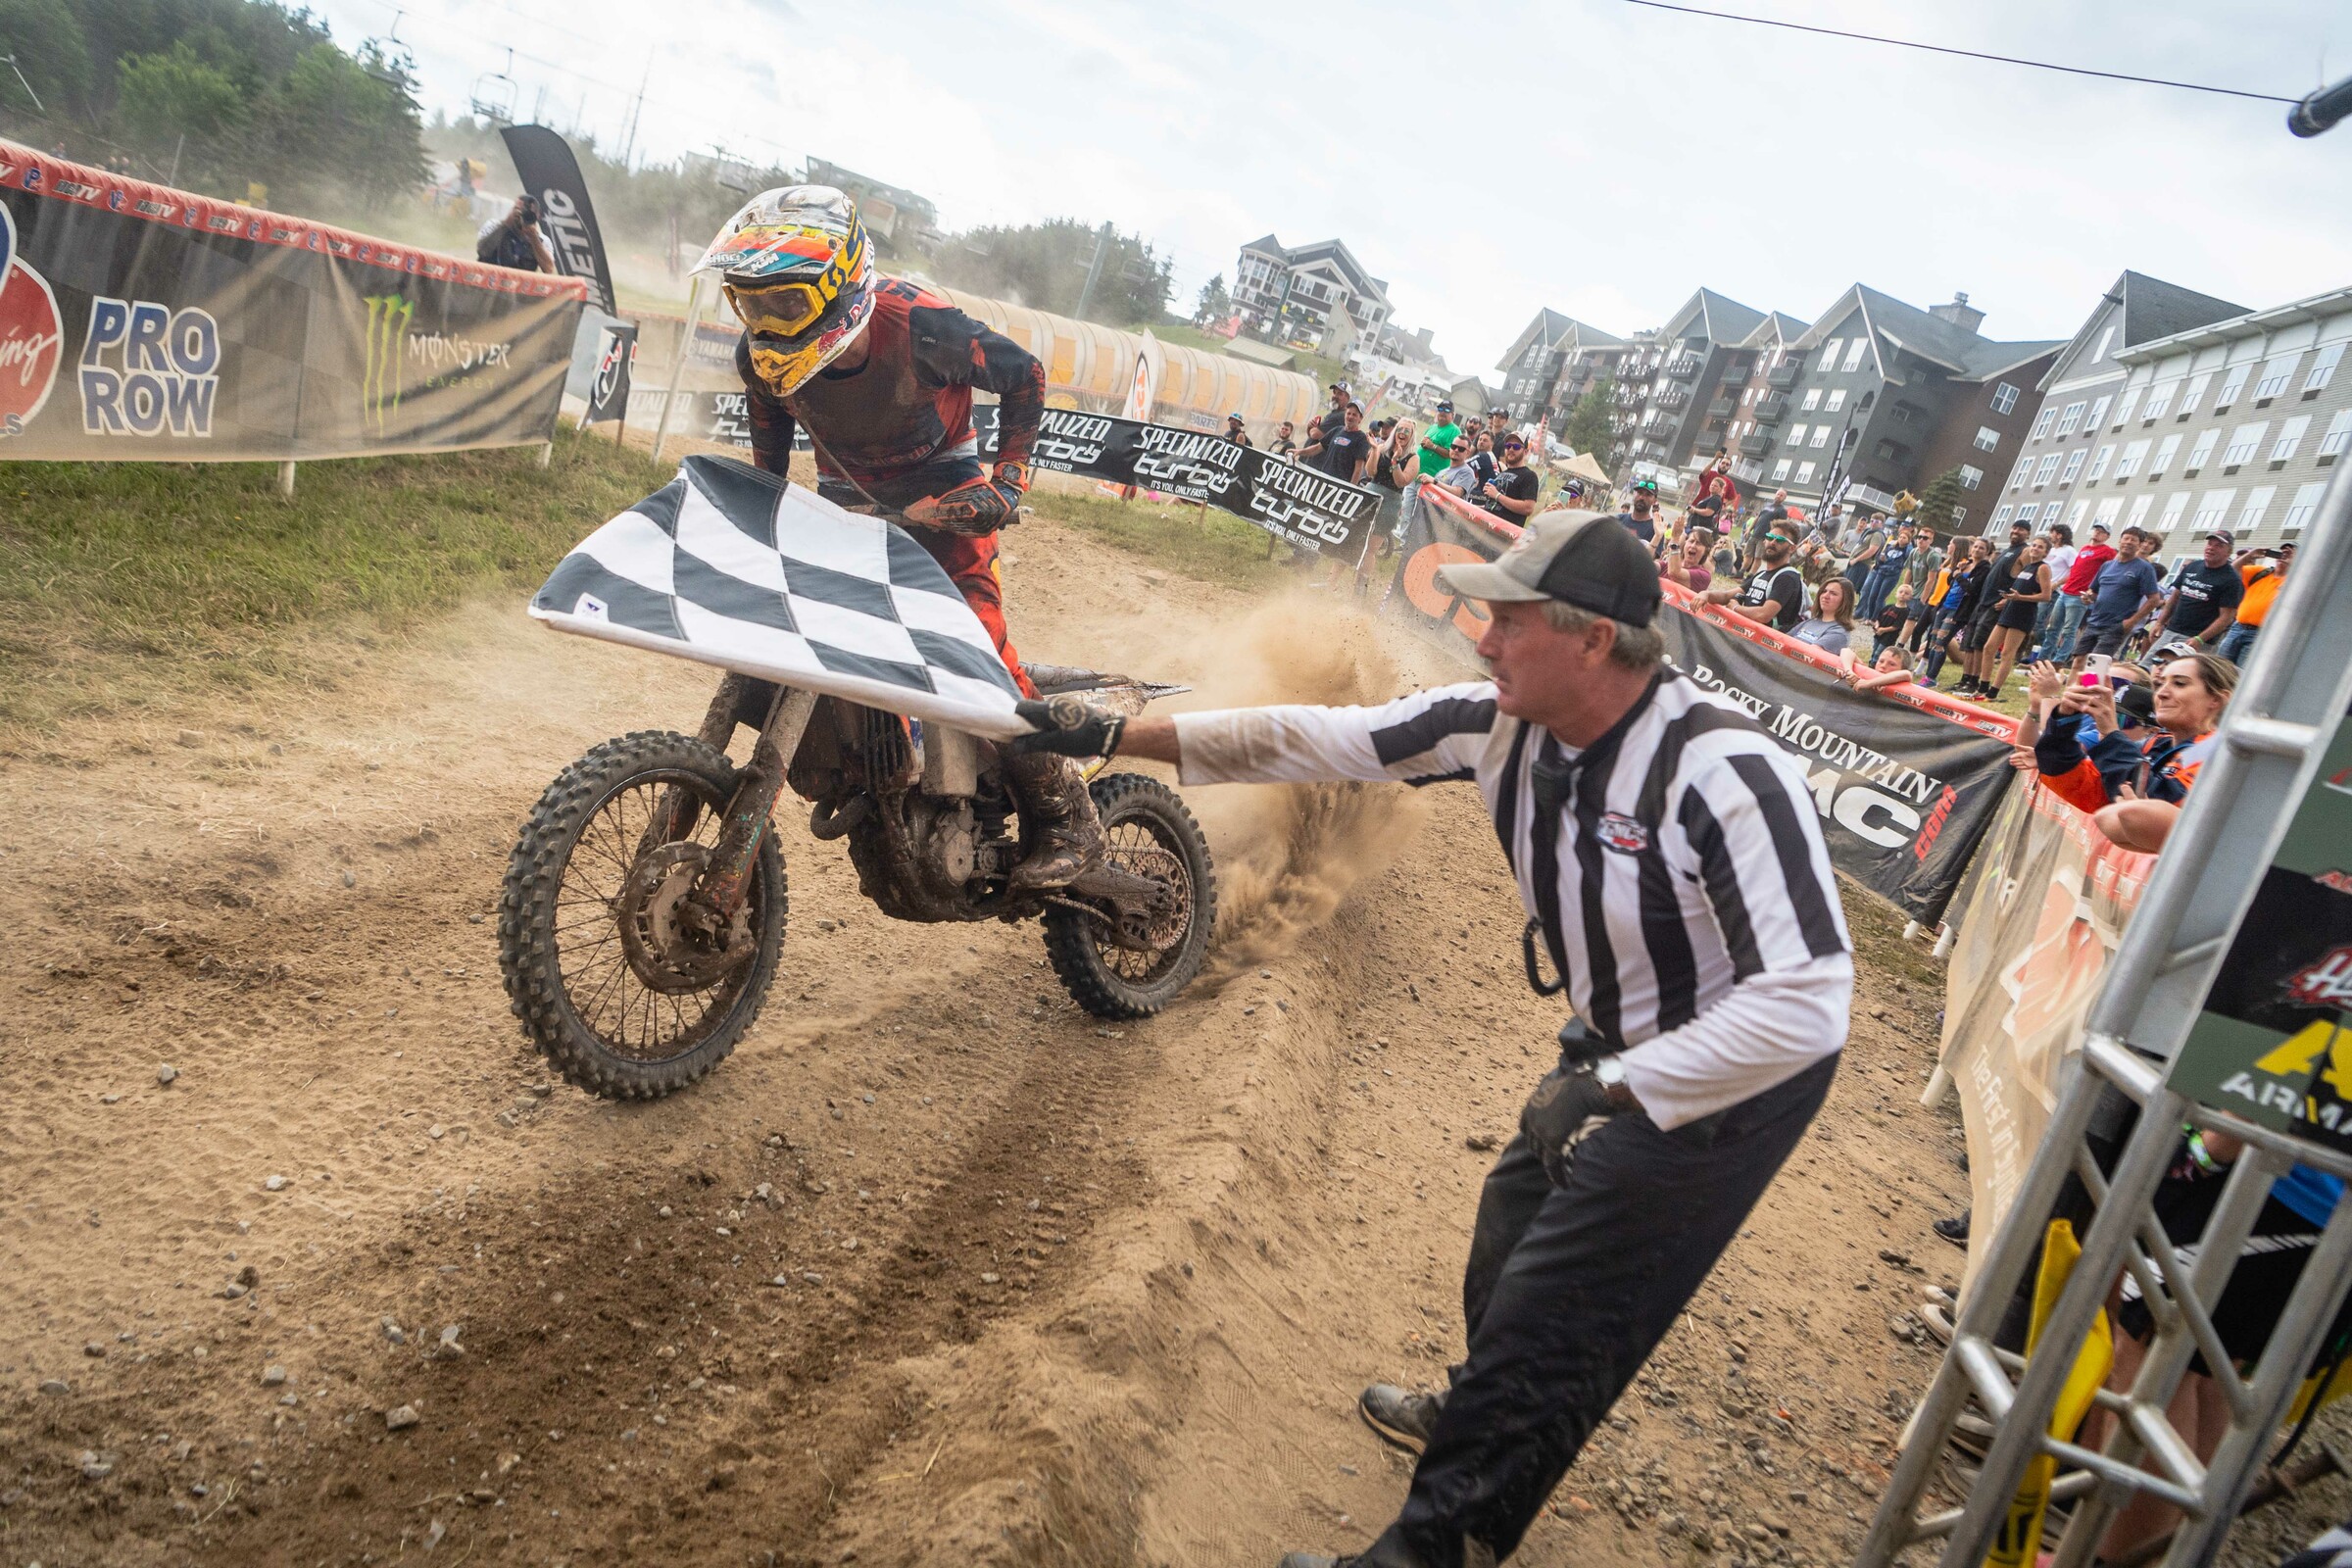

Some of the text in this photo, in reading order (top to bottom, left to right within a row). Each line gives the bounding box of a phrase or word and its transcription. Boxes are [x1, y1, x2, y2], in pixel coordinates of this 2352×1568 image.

[543, 187, 606, 308] METIC
[0, 324, 58, 387] ing
[78, 295, 221, 375] PRO
[408, 330, 512, 370] MONSTER
[77, 364, 220, 437] ROW
[1133, 425, 1244, 471] SPECIALIZED
[1175, 485, 1192, 497] ONLY
[1254, 458, 1364, 519] SPECIALIZED
[1286, 529, 1301, 543] ONLY
[1298, 535, 1321, 551] FASTER
[1768, 705, 1941, 804] MOUNTAIN
